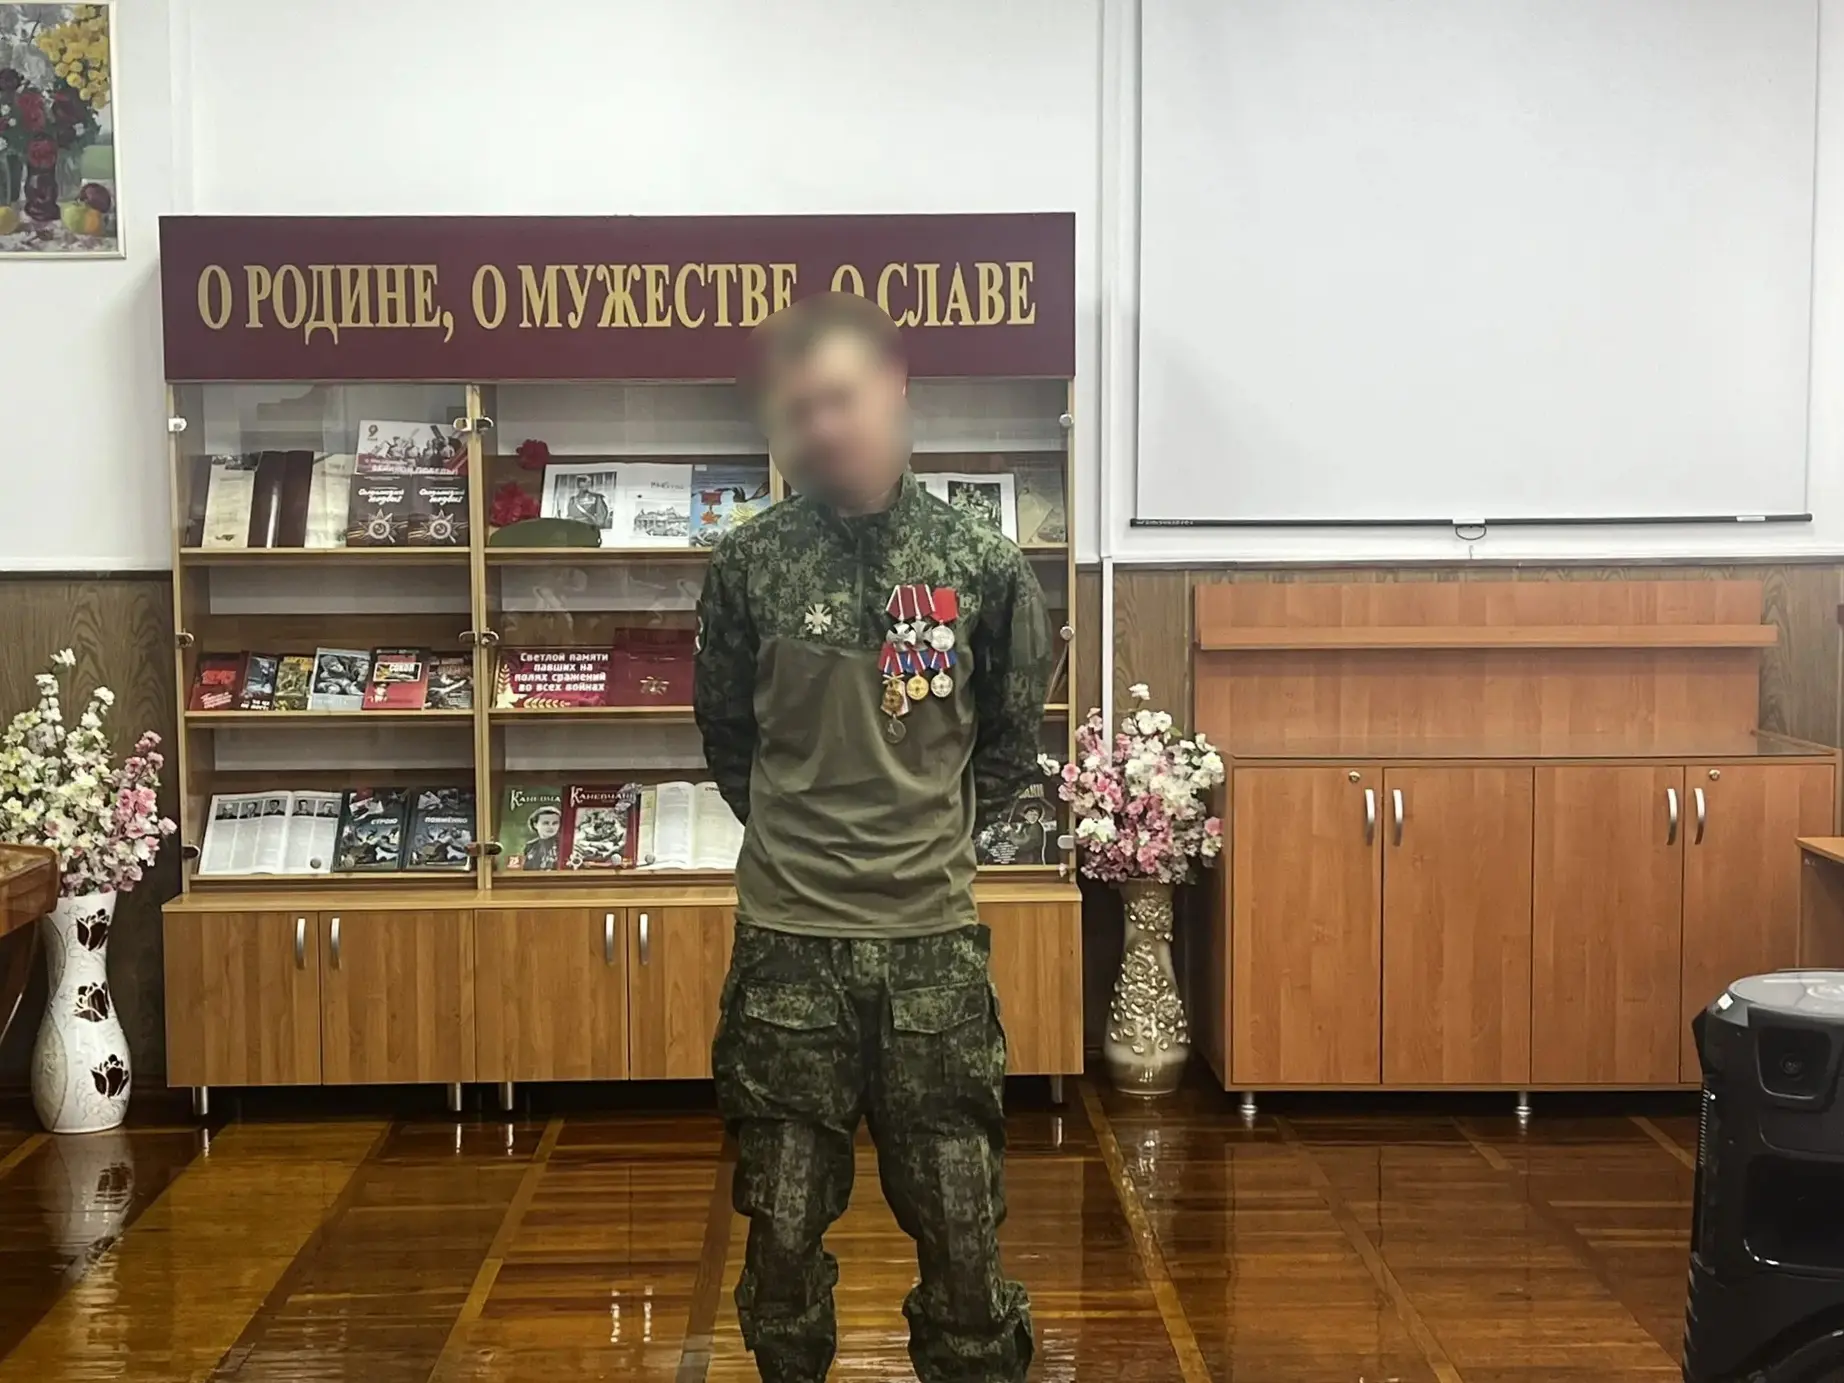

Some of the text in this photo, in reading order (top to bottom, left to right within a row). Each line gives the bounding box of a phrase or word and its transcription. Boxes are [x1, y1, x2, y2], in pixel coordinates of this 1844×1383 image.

[198, 265, 232, 329] О
[244, 264, 455, 344] РОДИНЕ,
[472, 264, 507, 329] О
[877, 262, 1036, 328] СЛАВЕ
[520, 652, 609, 661] Светлой памяти
[534, 663, 593, 671] павших на
[551, 672, 606, 682] сражений
[518, 684, 532, 692] во
[565, 683, 605, 691] войнах
